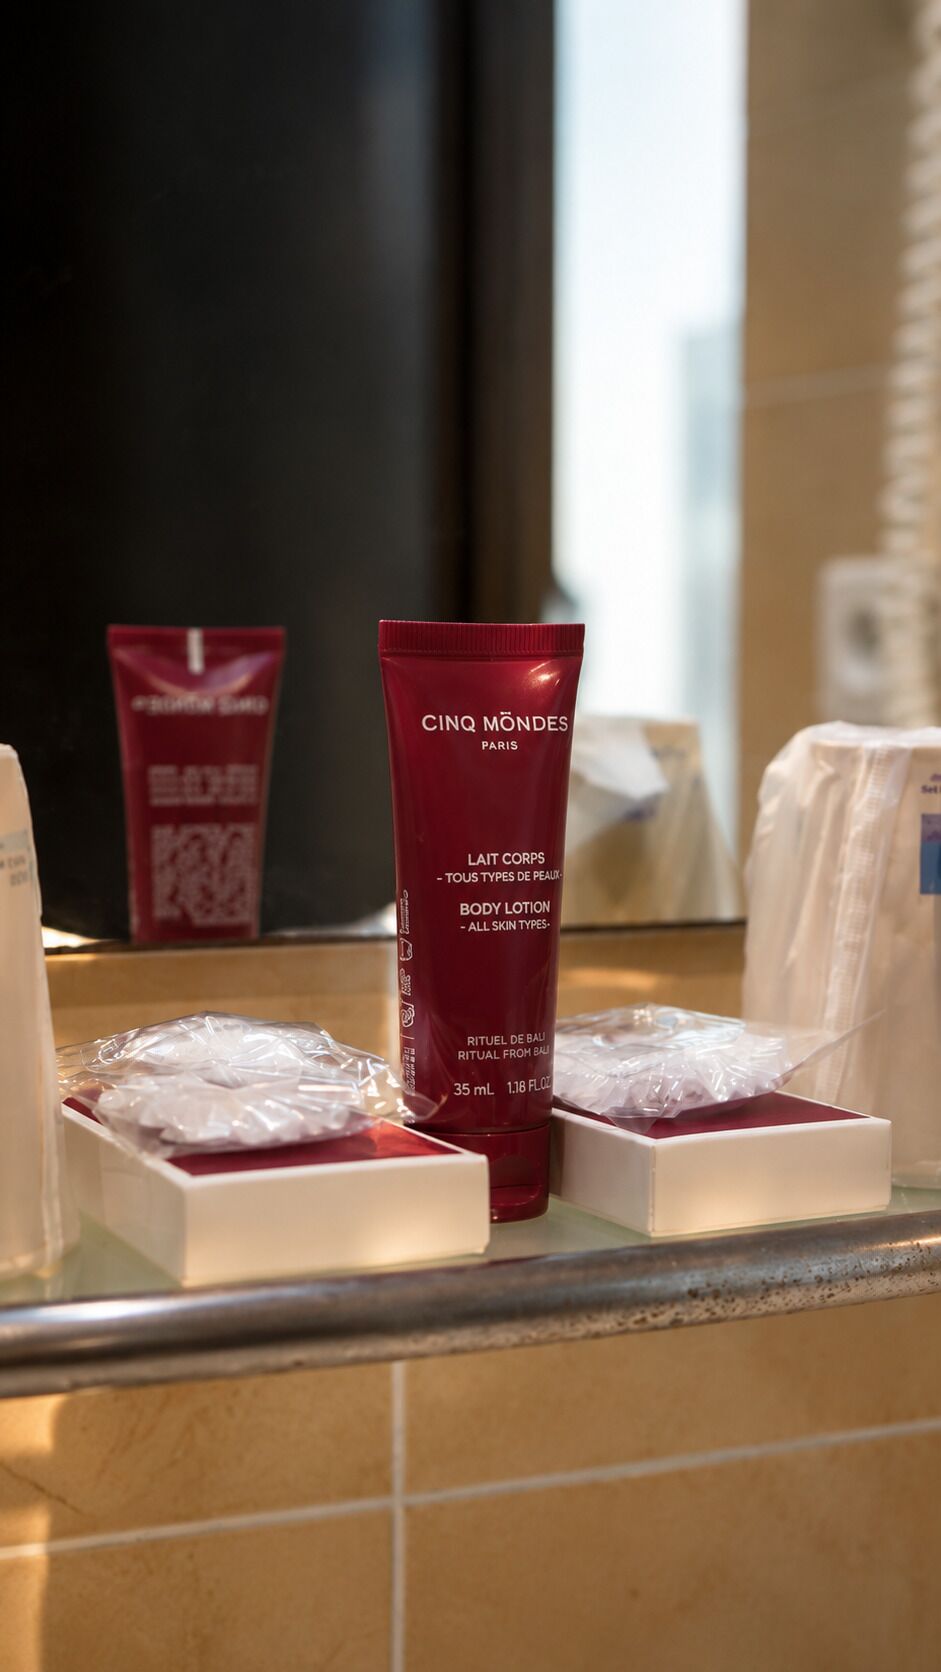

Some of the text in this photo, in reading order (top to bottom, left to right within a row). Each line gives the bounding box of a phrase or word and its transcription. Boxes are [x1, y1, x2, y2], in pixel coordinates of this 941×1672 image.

[421, 714, 476, 733] CINQ
[481, 741, 518, 750] PARIS
[468, 852, 545, 866] LAIT CORPS
[445, 872, 478, 883] TOUS
[480, 871, 515, 882] TYPES
[517, 871, 531, 881] DE
[460, 901, 550, 916] BODY LOTION
[468, 921, 490, 932] ALL
[492, 920, 517, 931] SKIN
[467, 1032, 546, 1046] RITUEL DE BALI
[458, 1045, 550, 1060] RITUAL FROM BALI
[453, 1082, 471, 1096] 35
[473, 1083, 495, 1096] mL
[507, 1080, 526, 1094] 1.18
